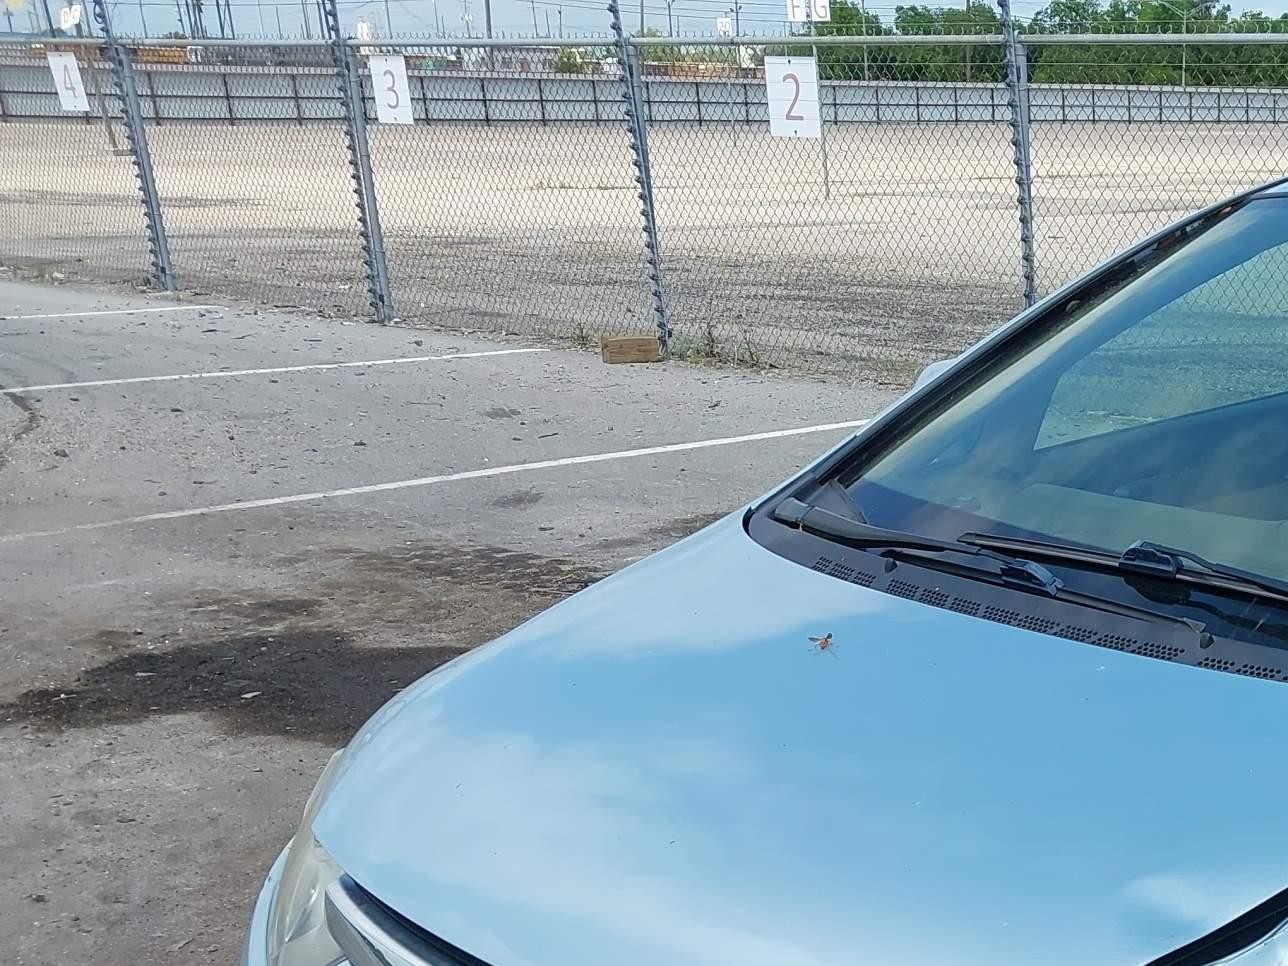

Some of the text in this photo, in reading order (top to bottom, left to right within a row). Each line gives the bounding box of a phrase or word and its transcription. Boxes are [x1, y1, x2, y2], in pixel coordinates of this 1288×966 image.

[64, 64, 77, 97] 4
[383, 69, 400, 109] 3
[782, 73, 804, 120] 2
